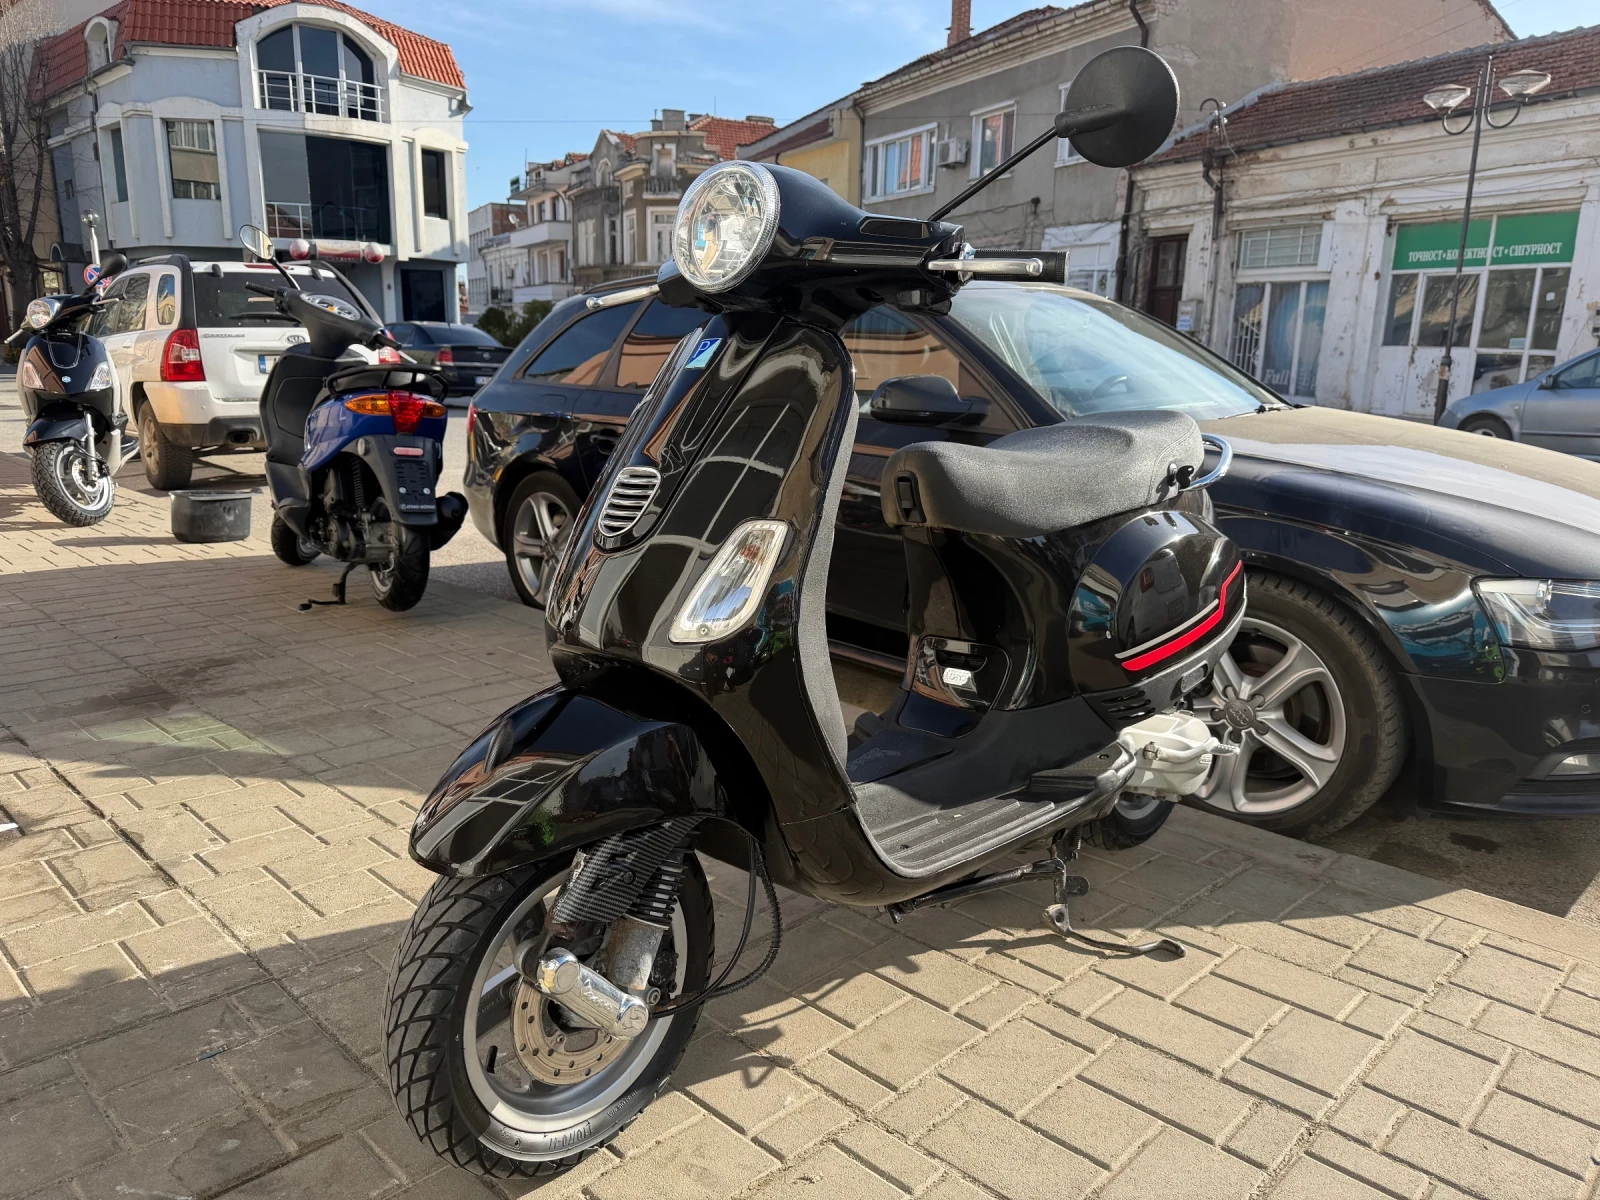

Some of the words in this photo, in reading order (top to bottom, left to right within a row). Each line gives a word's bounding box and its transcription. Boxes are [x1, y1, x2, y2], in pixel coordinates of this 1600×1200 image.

[1408, 249, 1443, 262] ТОЧНОСТ
[1446, 246, 1504, 260] КОЕКТНОСТ
[1509, 242, 1563, 257] СИГУРНОСТ
[1263, 368, 1289, 385] Full
